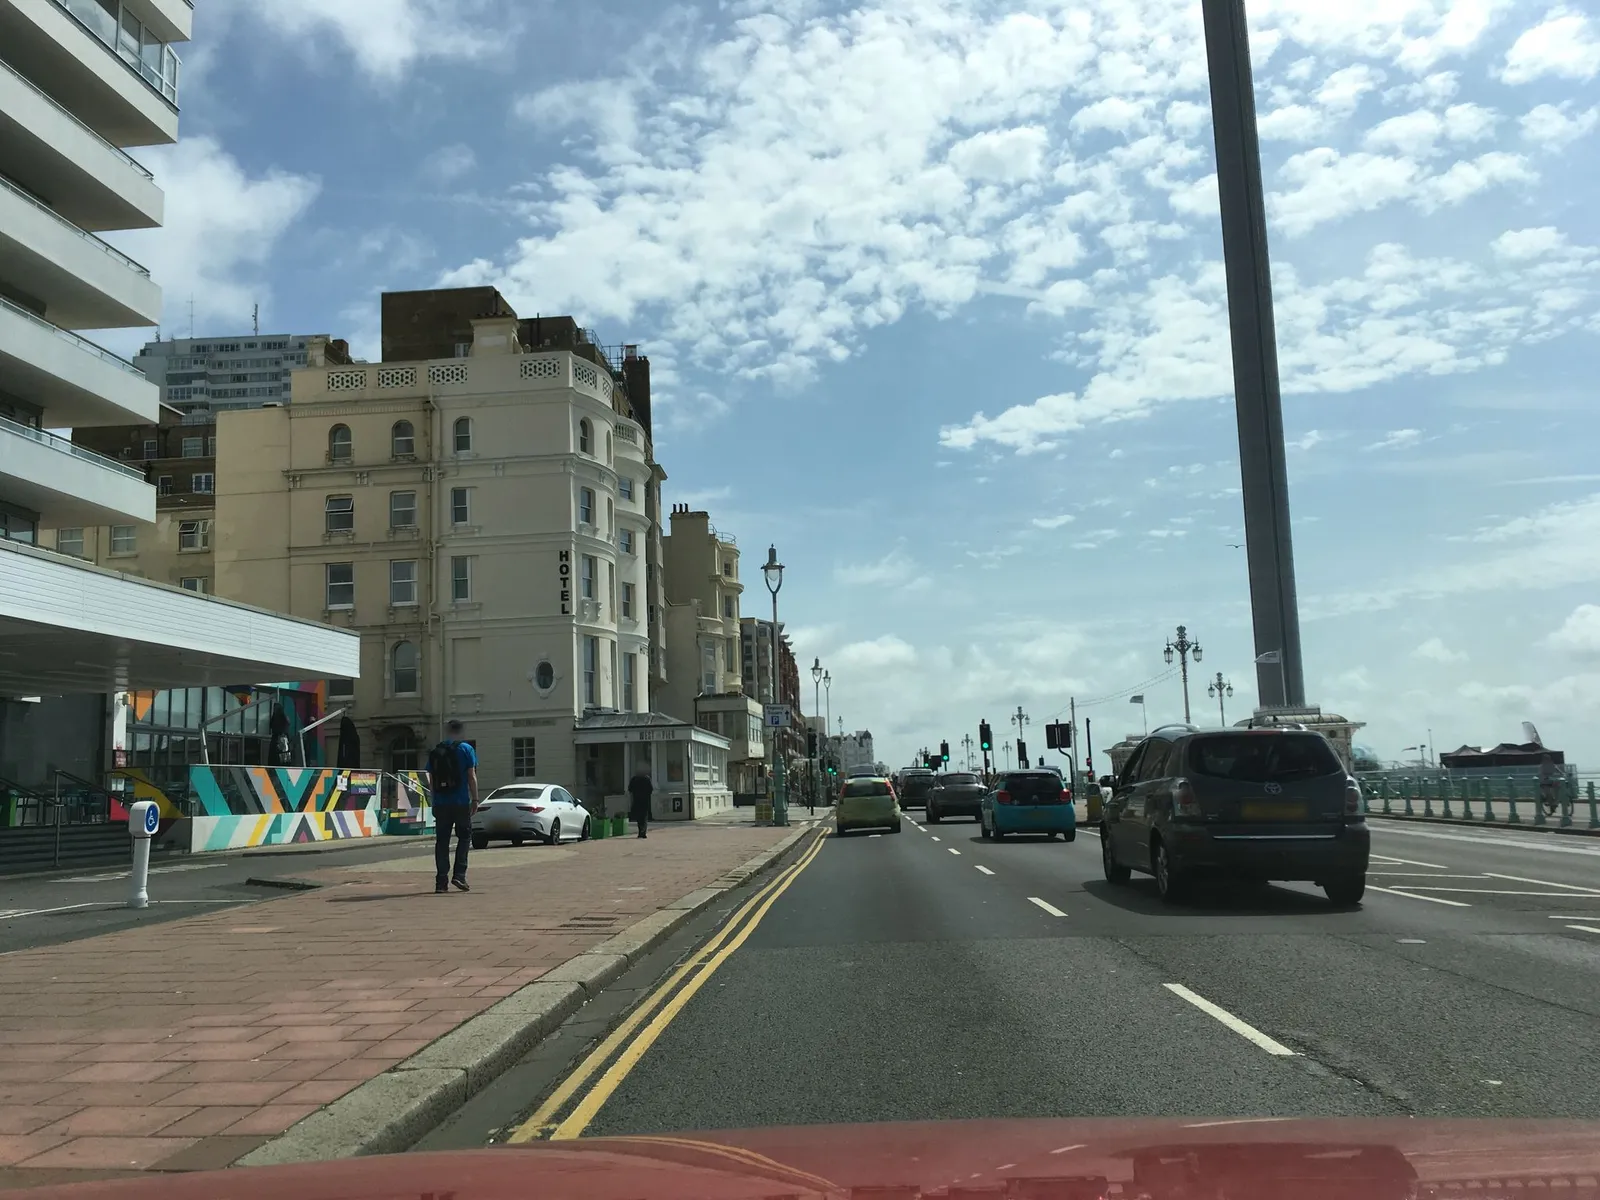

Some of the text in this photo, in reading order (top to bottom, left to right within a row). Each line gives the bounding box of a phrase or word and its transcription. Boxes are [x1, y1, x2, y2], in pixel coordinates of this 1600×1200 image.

[559, 550, 570, 615] HOTEL
[639, 729, 655, 740] WEST
[674, 800, 681, 810] P
